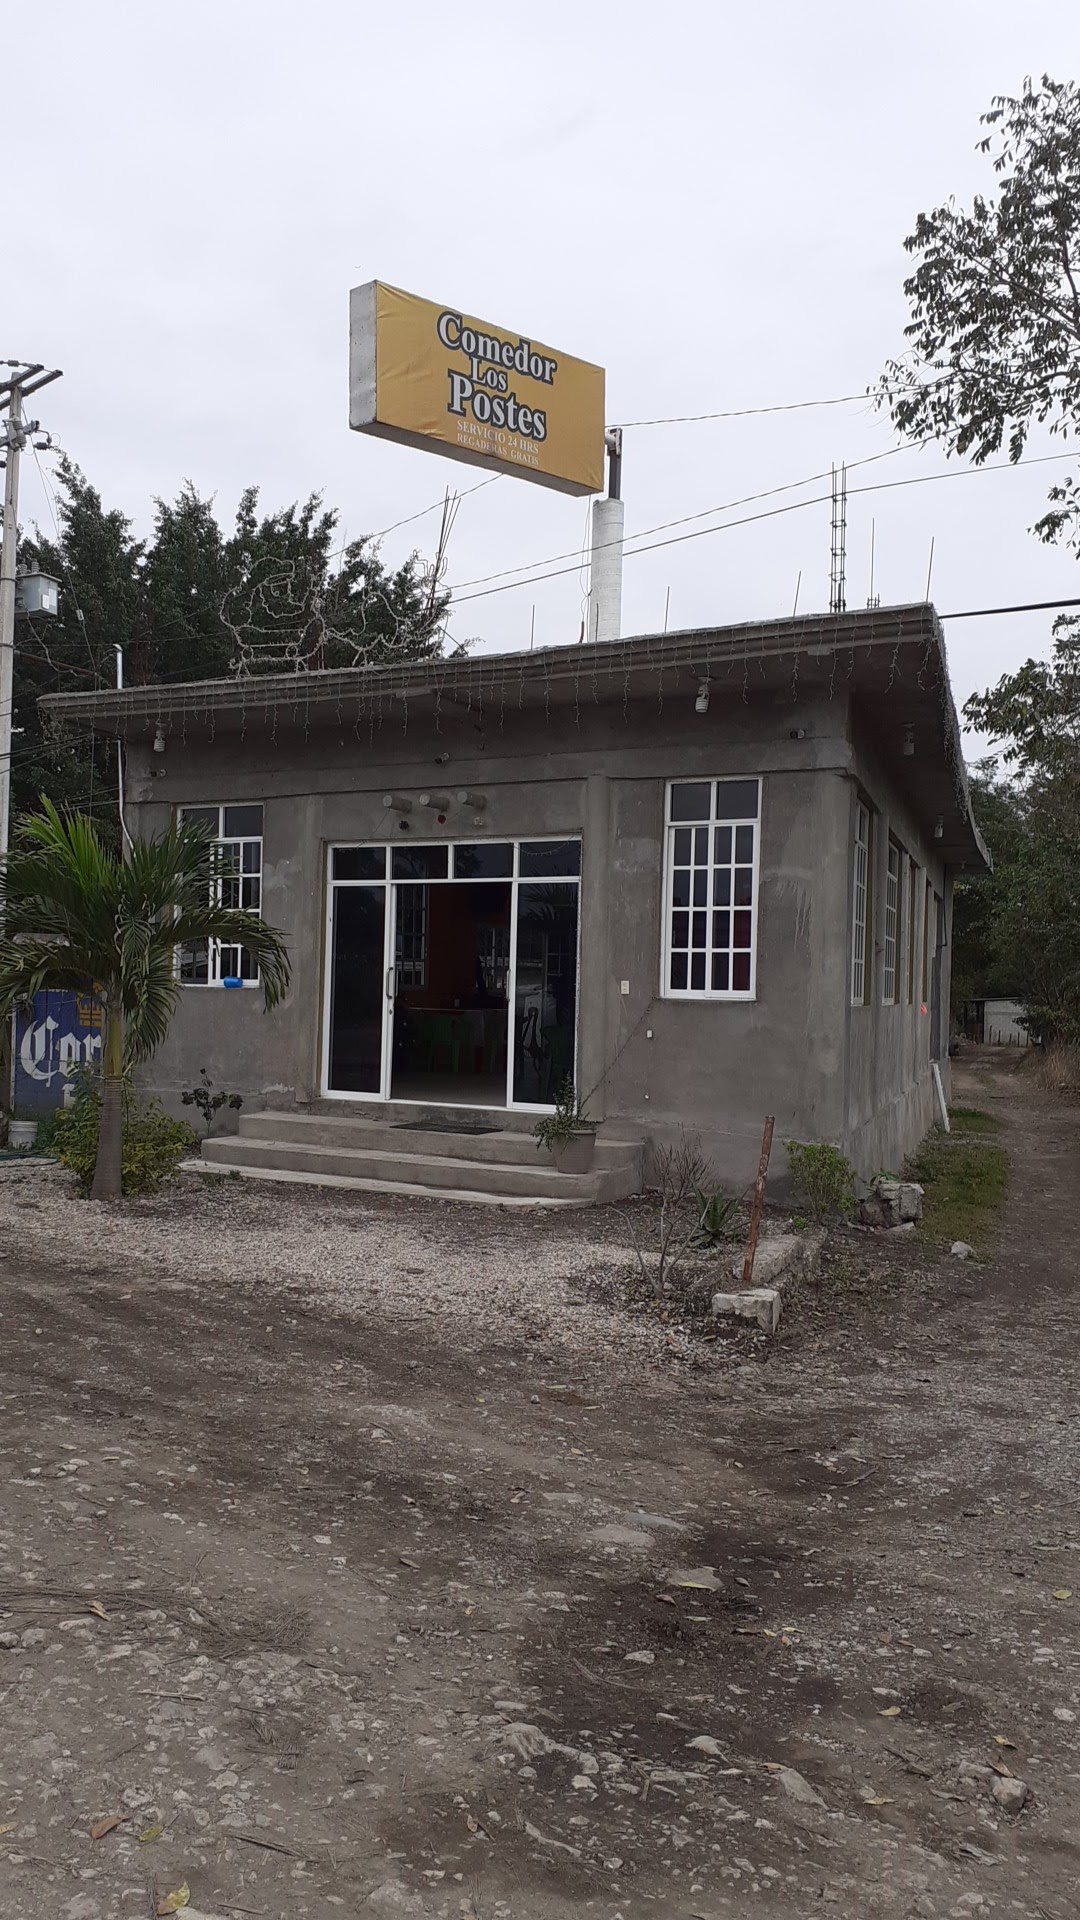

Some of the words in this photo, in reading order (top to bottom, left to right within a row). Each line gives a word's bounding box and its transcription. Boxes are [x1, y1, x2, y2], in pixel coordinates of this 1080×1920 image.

[438, 311, 557, 384] Comedor
[469, 356, 508, 392] Los
[448, 369, 546, 441] Postes
[457, 420, 506, 444] SERVICIO
[508, 435, 518, 447] 24
[519, 439, 539, 453] HRS
[457, 433, 507, 456] REGADERAS
[510, 449, 539, 465] GRATIS
